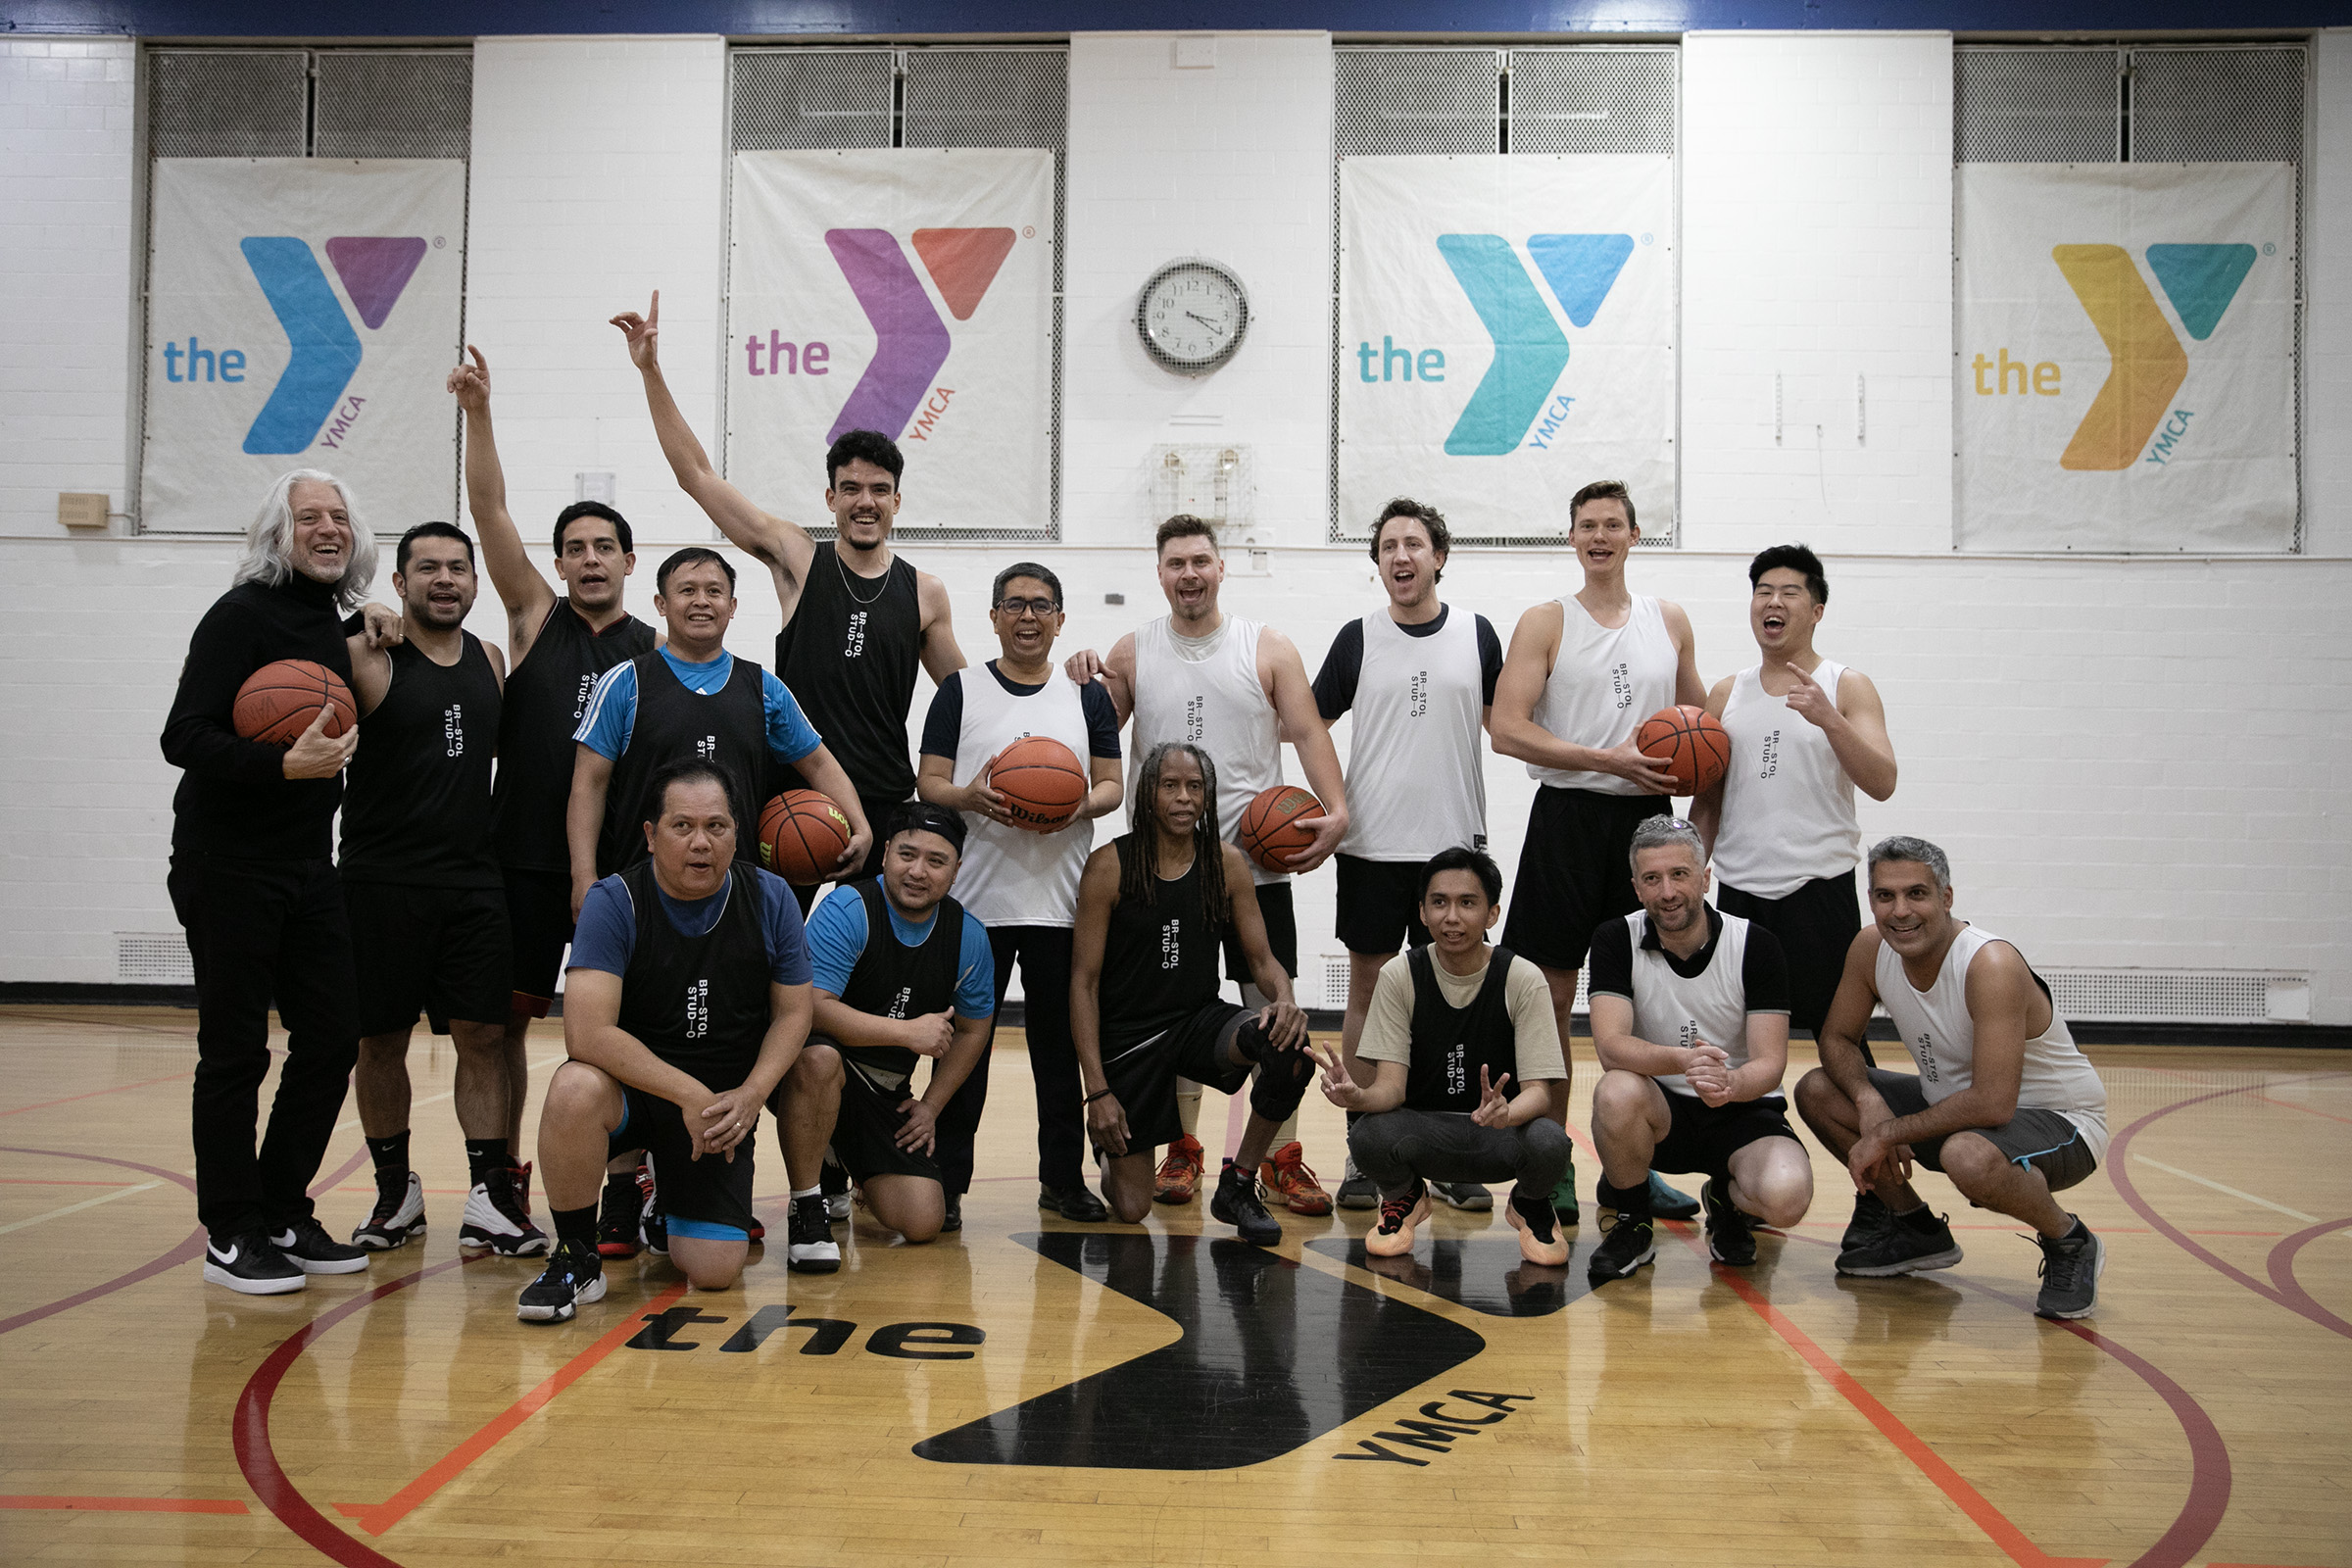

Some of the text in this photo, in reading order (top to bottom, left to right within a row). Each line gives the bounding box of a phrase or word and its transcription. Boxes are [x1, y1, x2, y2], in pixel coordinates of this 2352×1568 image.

[164, 337, 246, 383] the
[746, 329, 830, 376] the
[1356, 335, 1446, 383] the
[1972, 348, 2061, 396] the
[320, 396, 367, 450] YMCA
[908, 387, 956, 442] YMCA
[1529, 394, 1576, 451] YMCA
[2145, 409, 2195, 466] YMCA
[1010, 802, 1071, 824] Wilson
[624, 1304, 986, 1360] the
[1331, 1389, 1537, 1467] YMCA
